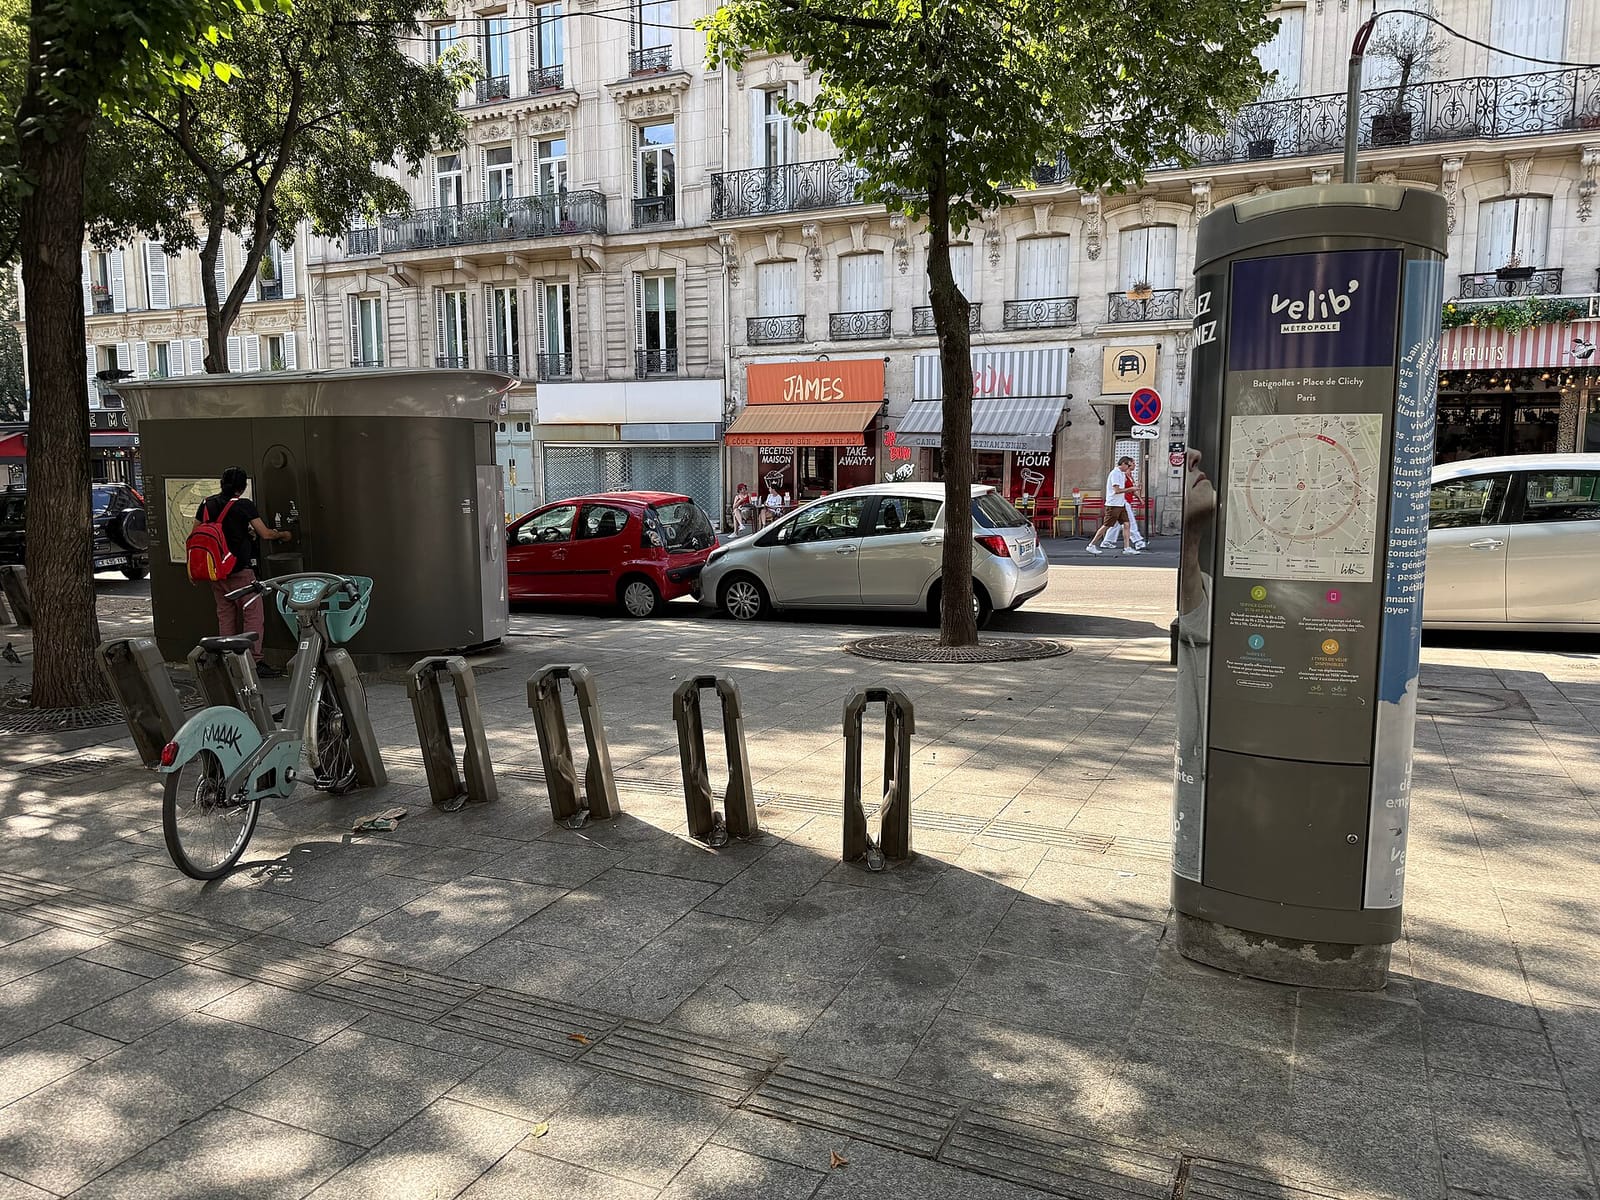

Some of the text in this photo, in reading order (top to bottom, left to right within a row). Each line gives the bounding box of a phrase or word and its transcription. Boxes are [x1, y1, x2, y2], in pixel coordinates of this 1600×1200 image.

[1463, 346, 1504, 361] FRUITS
[783, 374, 845, 402] JAMES
[1253, 376, 1364, 390] Batignolles Place de Clichy
[1296, 393, 1317, 402] Paris
[972, 439, 1028, 450] ETNAMIENNE
[759, 446, 794, 455] RECETTES
[845, 446, 868, 456] TAKE
[762, 455, 792, 465] MAISON
[838, 456, 875, 466] AWAYYY
[1016, 456, 1051, 466] HOUR
